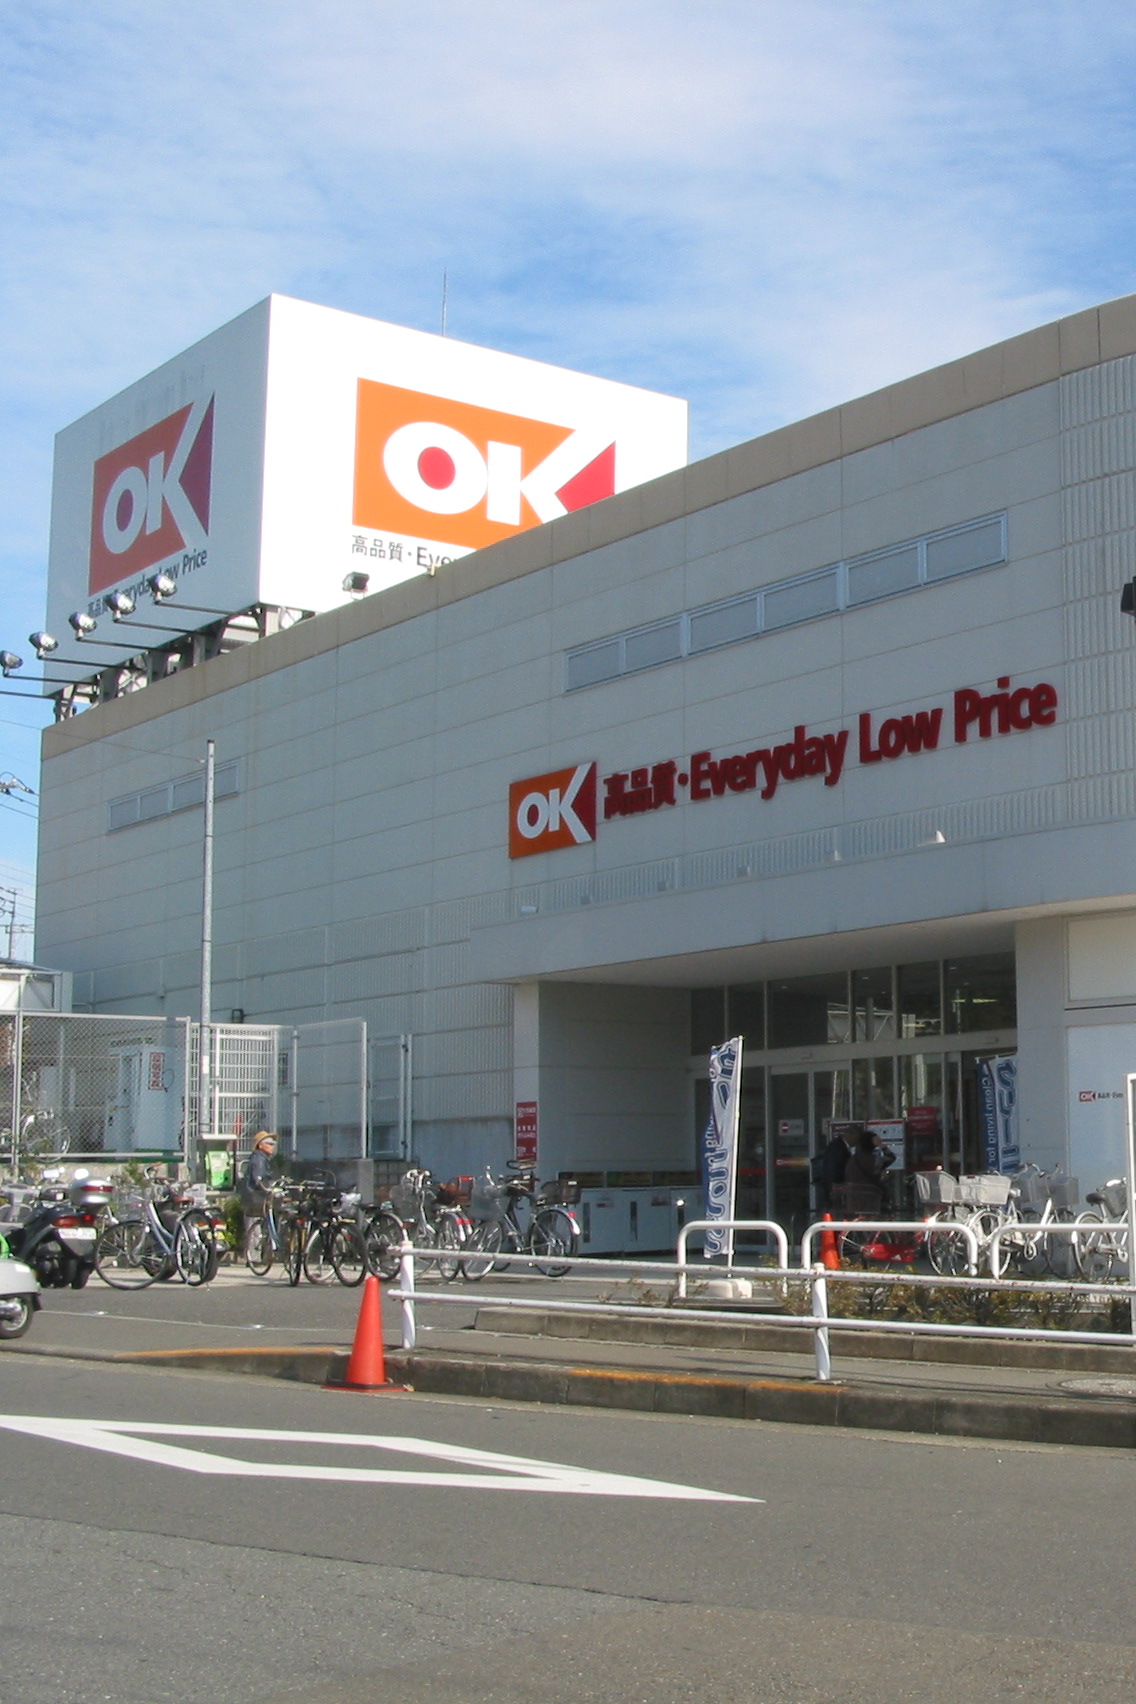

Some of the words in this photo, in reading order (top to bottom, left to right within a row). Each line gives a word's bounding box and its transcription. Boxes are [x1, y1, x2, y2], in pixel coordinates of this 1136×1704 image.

[102, 392, 214, 554] OK
[383, 421, 615, 526] OK
[182, 548, 208, 575] Price
[517, 762, 592, 844] OK
[690, 725, 849, 800] Everyday
[859, 708, 943, 763] Low
[954, 676, 1058, 743] Price
